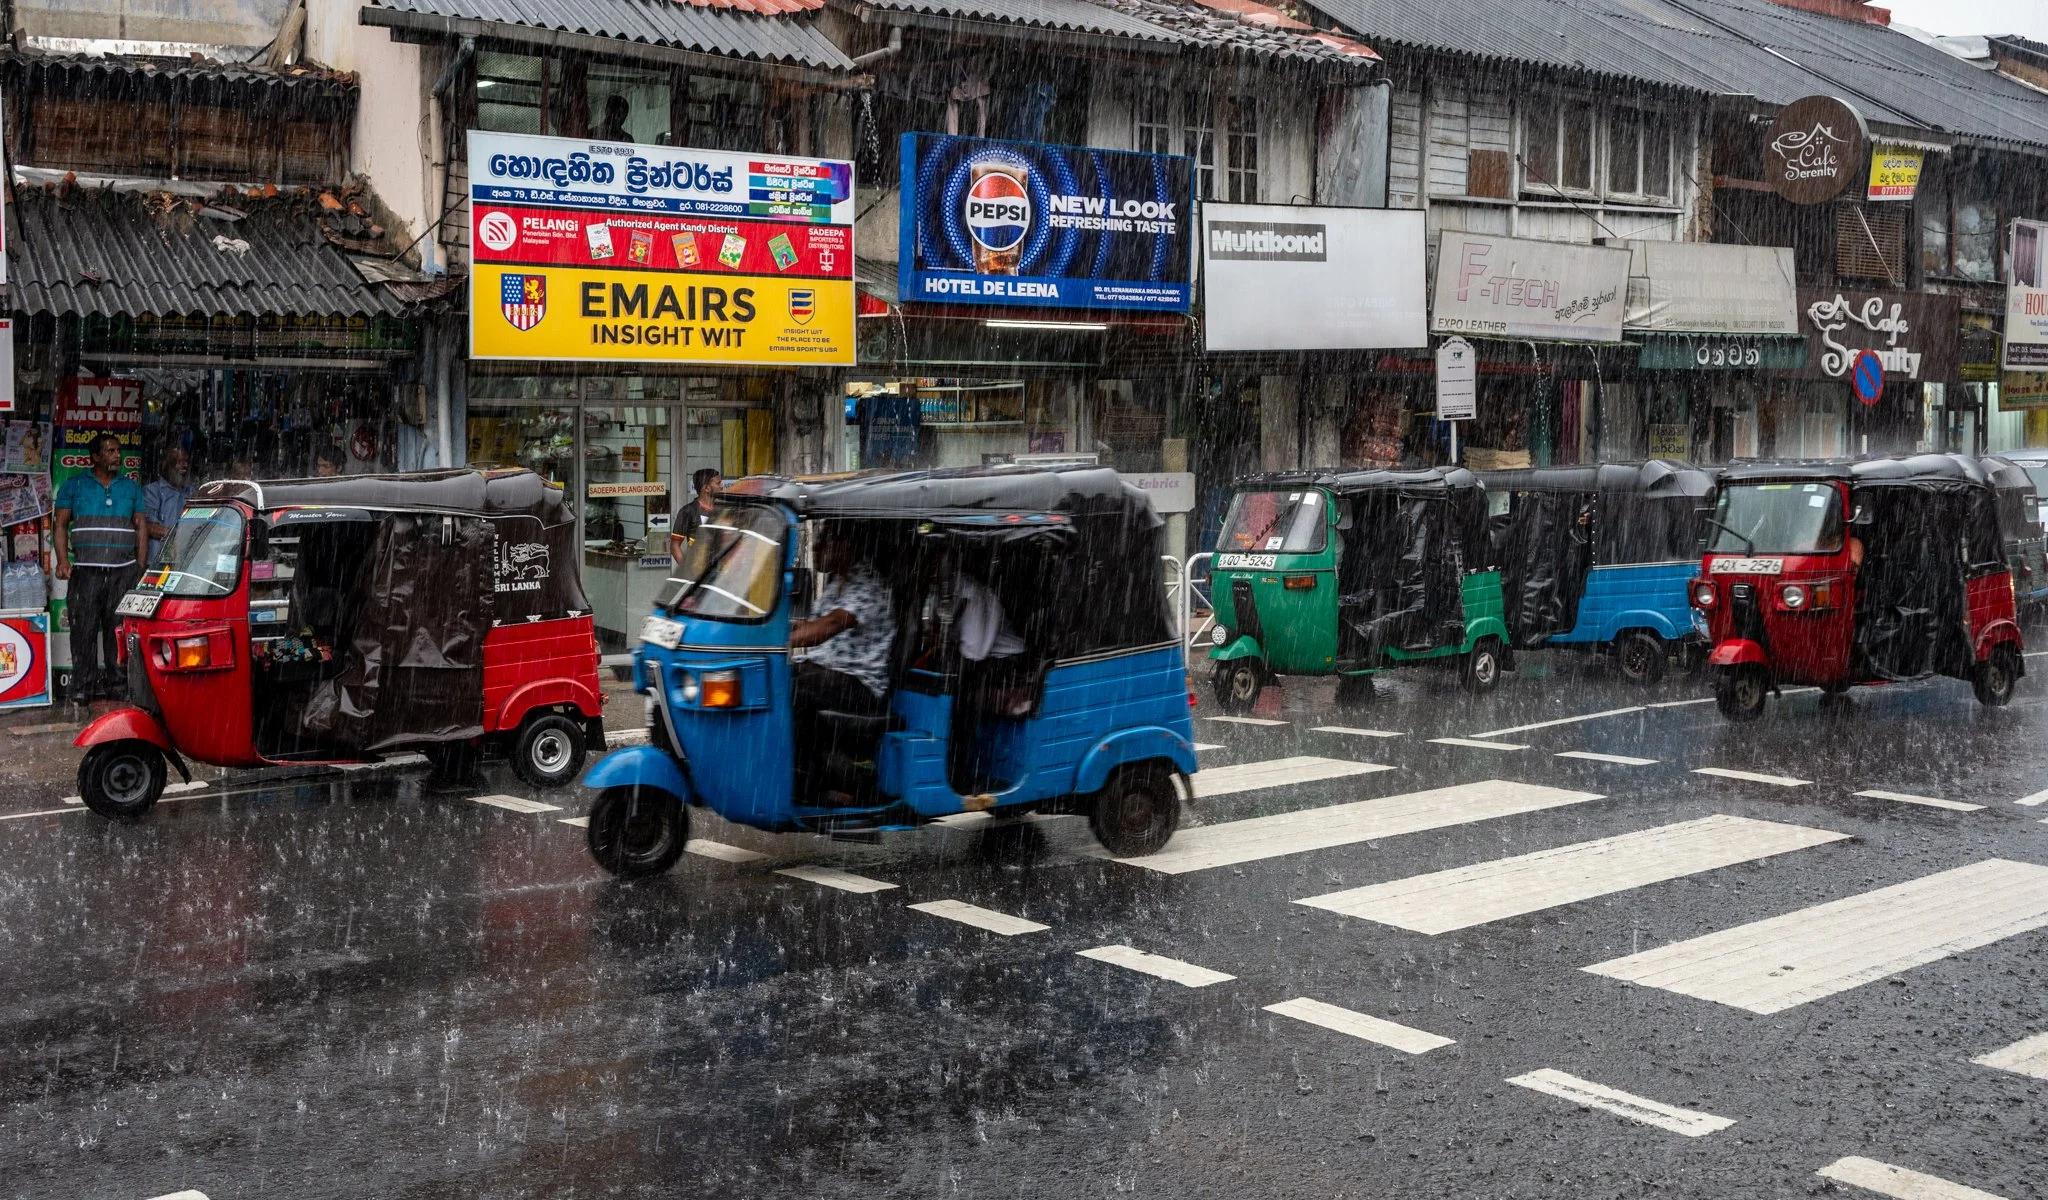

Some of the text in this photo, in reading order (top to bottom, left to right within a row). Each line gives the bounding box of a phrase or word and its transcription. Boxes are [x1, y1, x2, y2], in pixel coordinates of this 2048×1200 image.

[589, 145, 635, 156] ESTD 1939
[1800, 144, 1838, 168] Cafe
[489, 153, 615, 188] හොඳහිත
[1785, 159, 1838, 181] Serenity
[1881, 186, 1897, 195] 0777
[492, 189, 511, 199] අංක
[514, 190, 527, 200] 79,
[696, 202, 743, 213] 081-2228600
[1050, 194, 1176, 219] NEW LOOK
[970, 203, 1027, 221] PEPSI
[522, 230, 551, 238] Penerbitan
[605, 218, 738, 234] Authorized Agent Kandy District
[808, 228, 845, 237] SADEEPA
[1050, 215, 1176, 235] REFRESHING TASTE
[809, 236, 838, 244] IMPORTERS
[1211, 230, 1324, 254] Multibond
[1457, 242, 1560, 309] F-TECH
[925, 278, 1059, 298] HOTEL DE LEENA
[580, 281, 757, 323] EMAIRS
[1438, 317, 1462, 329] EXPO
[1465, 318, 1507, 332] LEATHER
[1861, 297, 1909, 346] Cafe
[591, 324, 746, 349] INSIGHT WIT
[77, 385, 140, 408] MZ
[589, 484, 665, 495] SADEEPA PELANGI BOOKS
[1138, 478, 1180, 489] Fabrics
[1248, 555, 1275, 567] 5243
[494, 580, 541, 592] SRI LANKA
